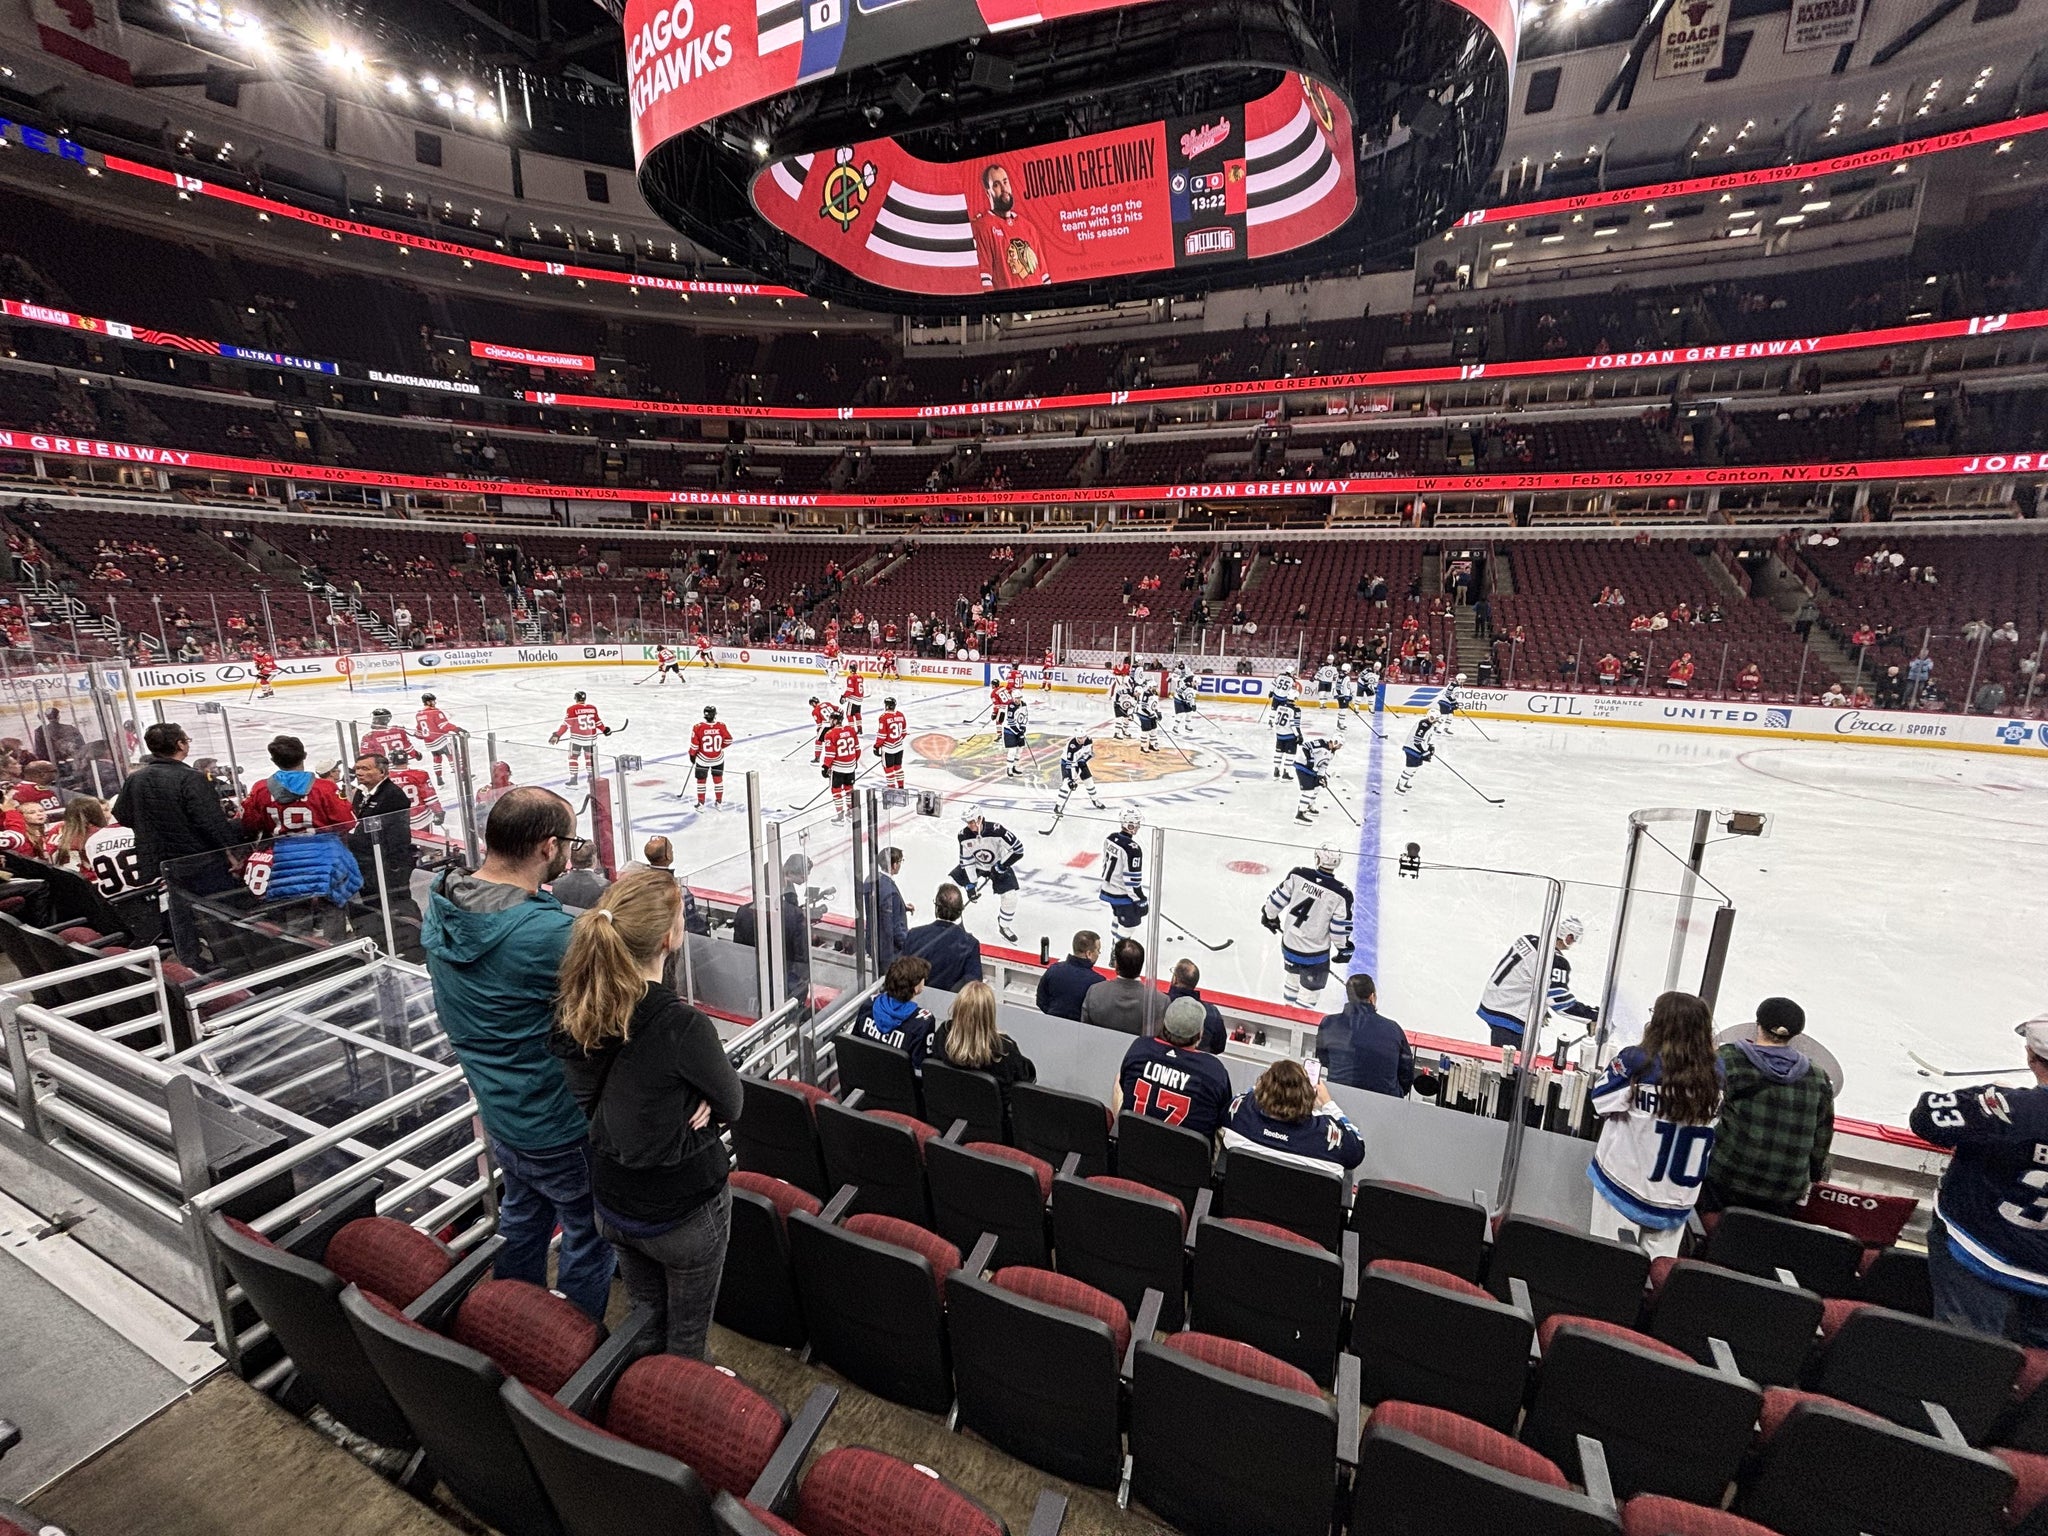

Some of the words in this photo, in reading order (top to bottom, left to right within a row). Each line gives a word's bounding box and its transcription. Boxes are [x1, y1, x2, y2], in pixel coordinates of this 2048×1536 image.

[820, 4, 831, 23] 0
[1023, 154, 1076, 200] JORDAN
[1077, 138, 1156, 191] GREENWAY
[1568, 197, 1588, 209] LW
[1662, 182, 1684, 196] 231
[1711, 175, 1740, 189] Feb
[1743, 171, 1762, 186] 16,
[1769, 167, 1801, 181] 1997
[1831, 149, 1895, 171] Canton,
[1902, 140, 1929, 156] NY,
[1936, 132, 1973, 149] USA
[174, 172, 203, 192] 12
[1059, 206, 1088, 221] Ranks
[1089, 203, 1109, 217] 2nd
[1110, 203, 1123, 214] on
[1123, 198, 1143, 211] the
[1192, 194, 1225, 210] 13:22
[1061, 220, 1088, 233] team
[1088, 215, 1110, 229] with
[1111, 213, 1123, 225] 13
[1124, 209, 1143, 223] hits
[1463, 210, 1486, 226] 12
[296, 210, 371, 236] JORDAN
[381, 229, 475, 258] GREENWAY
[1076, 227, 1096, 242] this
[1096, 225, 1130, 239] season
[545, 261, 565, 276] 12
[629, 275, 683, 291] JORDAN
[689, 281, 760, 295] GREENWAY
[21, 304, 70, 325] CHICAGO
[1968, 313, 2007, 335] 12
[236, 348, 272, 362] ULTRA
[284, 356, 321, 370] CLUB
[485, 346, 525, 362] CHICAGO
[526, 352, 583, 367] BLACKHAWKS
[1586, 350, 1674, 369] JORDAN
[1686, 338, 1821, 361] GREENWAY
[1461, 364, 1486, 380] 12
[369, 370, 480, 394] BLACKHAWKS.COM
[1203, 382, 1266, 395] JORDAN
[1274, 374, 1368, 388] GREENWAY
[633, 401, 689, 413] JORDAN
[696, 405, 772, 416] GREENWAY
[918, 403, 967, 417] JORDAN
[971, 399, 1043, 413] GREENWAY
[31, 436, 190, 464] GREENWAY
[1416, 479, 1436, 489] LW
[1518, 476, 1542, 487] 231
[1572, 474, 1599, 486] Feb
[1606, 473, 1628, 486] 16,
[1635, 472, 1673, 485] 1997
[1706, 469, 1773, 483] Canton,
[1782, 467, 1809, 481] NY,
[1820, 465, 1860, 478] USA
[377, 474, 400, 486] 231
[425, 479, 449, 490] Feb
[452, 481, 471, 493] 16,
[476, 483, 504, 494] 1997
[526, 486, 571, 498] Canton,
[575, 488, 593, 500] NY,
[596, 490, 619, 499] USA
[1165, 484, 1238, 498] JORDAN
[1244, 481, 1350, 495] GREENWAY
[670, 492, 731, 504] JORDAN
[738, 494, 818, 506] GREENWAY
[863, 496, 877, 505] LW
[925, 495, 940, 504] 231
[956, 493, 974, 503] Feb
[977, 493, 990, 503] 16,
[993, 493, 1014, 503] 1997
[1032, 491, 1071, 502] Canton,
[1074, 490, 1092, 501] NY,
[1095, 489, 1115, 499] USA
[444, 650, 493, 662] Gallagher
[449, 658, 489, 666] INSURANCE
[518, 649, 558, 662] Modelo
[721, 652, 738, 661] BMO
[771, 655, 813, 665] UNITED
[138, 669, 205, 687] Illinois
[248, 663, 321, 678] LXUS
[921, 664, 949, 674] BELLE
[951, 667, 972, 676] TIRE
[1199, 677, 1263, 695] EICO
[1304, 686, 1317, 697] Byl
[1455, 689, 1509, 701] ndeavor
[1458, 701, 1487, 711] ealth
[1527, 694, 1581, 716] GTL
[1594, 698, 1643, 707] GUARANTEE
[578, 714, 596, 731] 55
[1664, 706, 1758, 722] UNITED
[420, 721, 430, 737] 8
[1835, 710, 1896, 734] Circa
[1907, 724, 1947, 737] SPORTS
[702, 736, 723, 752] 20
[836, 737, 856, 757] 22
[40, 796, 60, 810] 88
[1132, 857, 1141, 868] 61
[1301, 882, 1324, 900] PIONK
[1289, 896, 1314, 928] 4
[1552, 968, 1567, 984] 91
[1142, 1060, 1192, 1091] LOWRY
[1132, 1078, 1192, 1127] 17
[1928, 1093, 1966, 1128] 33
[1262, 1127, 1290, 1143] Reebok
[1647, 1120, 1715, 1188] 10
[1818, 1189, 1861, 1208] CIBC
